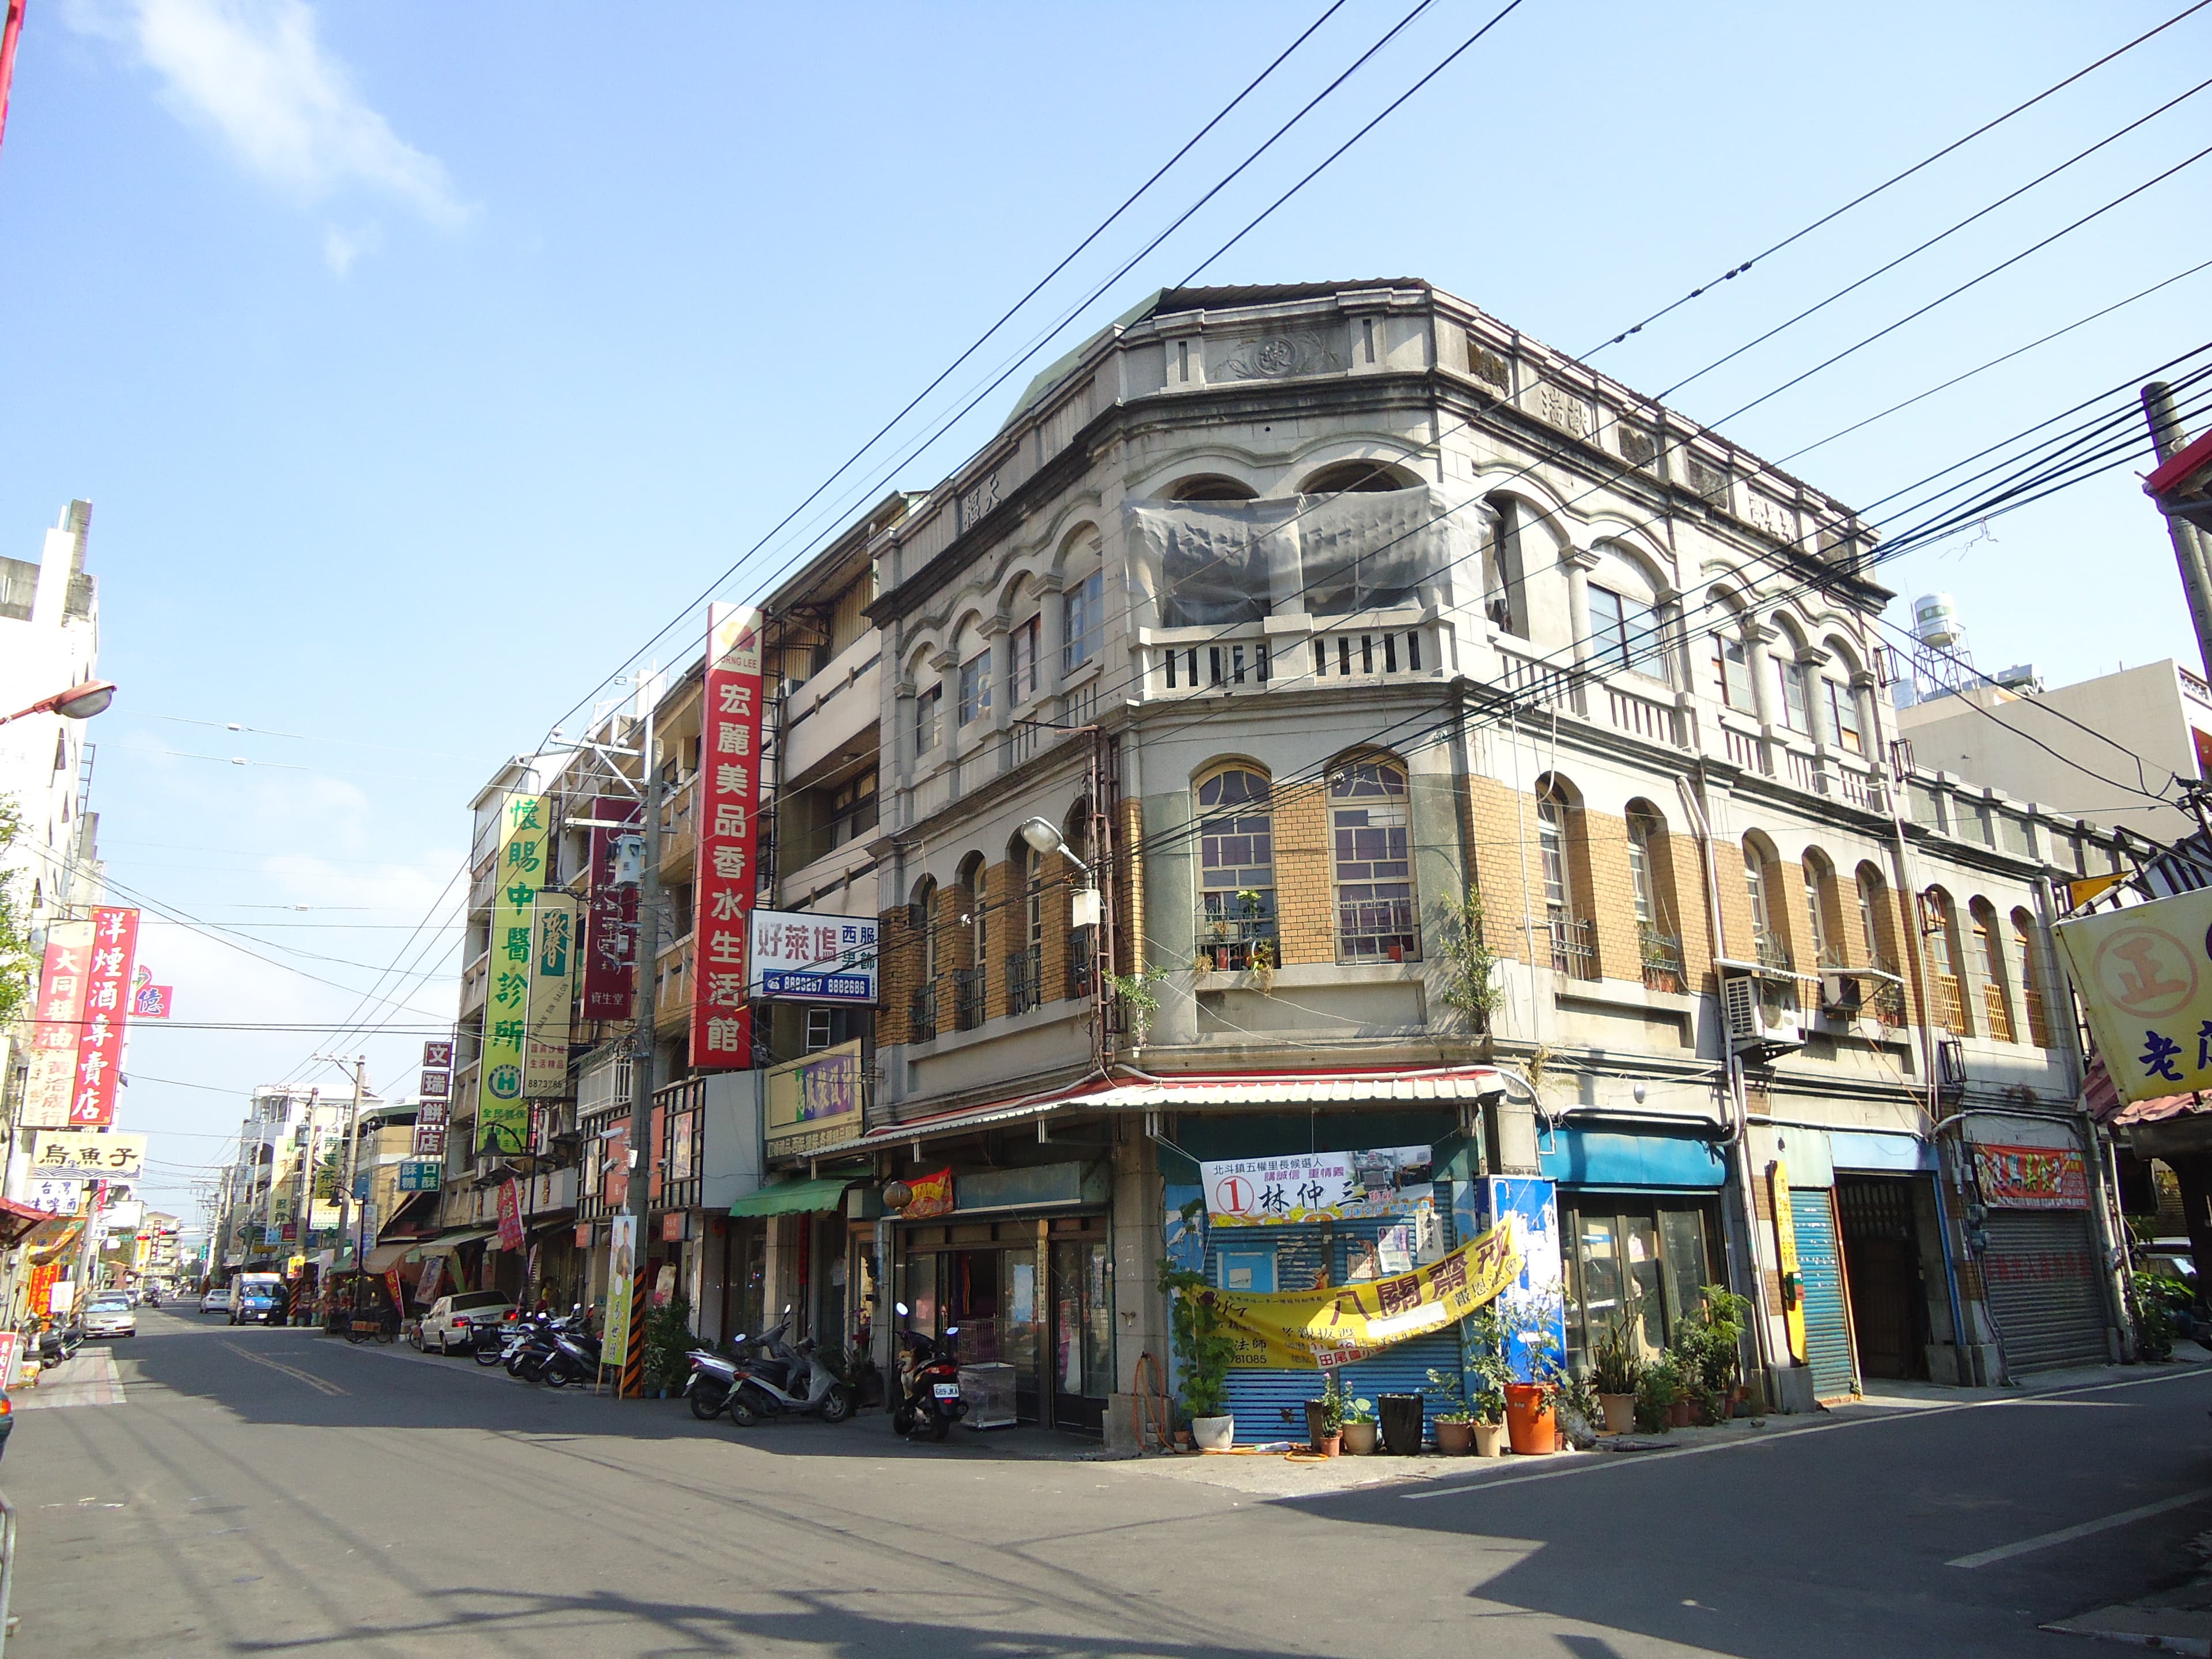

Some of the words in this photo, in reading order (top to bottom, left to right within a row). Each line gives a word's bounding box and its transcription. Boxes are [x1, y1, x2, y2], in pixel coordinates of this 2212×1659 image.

[743, 659, 757, 669] LEE
[706, 683, 752, 1052] 宏麗美品香水生活館
[493, 798, 543, 1054] 懷賜中醫診所
[757, 922, 837, 962] 好萊塢
[842, 925, 876, 945] 西服
[842, 950, 876, 971] 男飾
[2112, 937, 2188, 1006] 正
[41, 949, 83, 1048] 大同醬油
[138, 988, 165, 1014] 億
[547, 1002, 556, 1014] SIN
[553, 983, 569, 1002] SALON
[590, 991, 624, 1006] 資生堂
[71, 911, 127, 1120] 洋煙酒專賣店
[529, 1059, 564, 1069] 生活精品
[2139, 1020, 2212, 1082] 老
[418, 1044, 448, 1152] 文瑞餅店
[39, 1143, 139, 1167] 烏魚子
[1214, 1157, 1324, 1176] 北斗鎮五權里長候選人
[41, 1181, 72, 1195] 台灣
[1264, 1169, 1300, 1182] 講誠信
[1308, 1166, 1345, 1180] 重情義
[1224, 1178, 1246, 1213] 1
[1257, 1180, 1365, 1214] 林仲三
[1234, 1337, 1267, 1353] 法師
